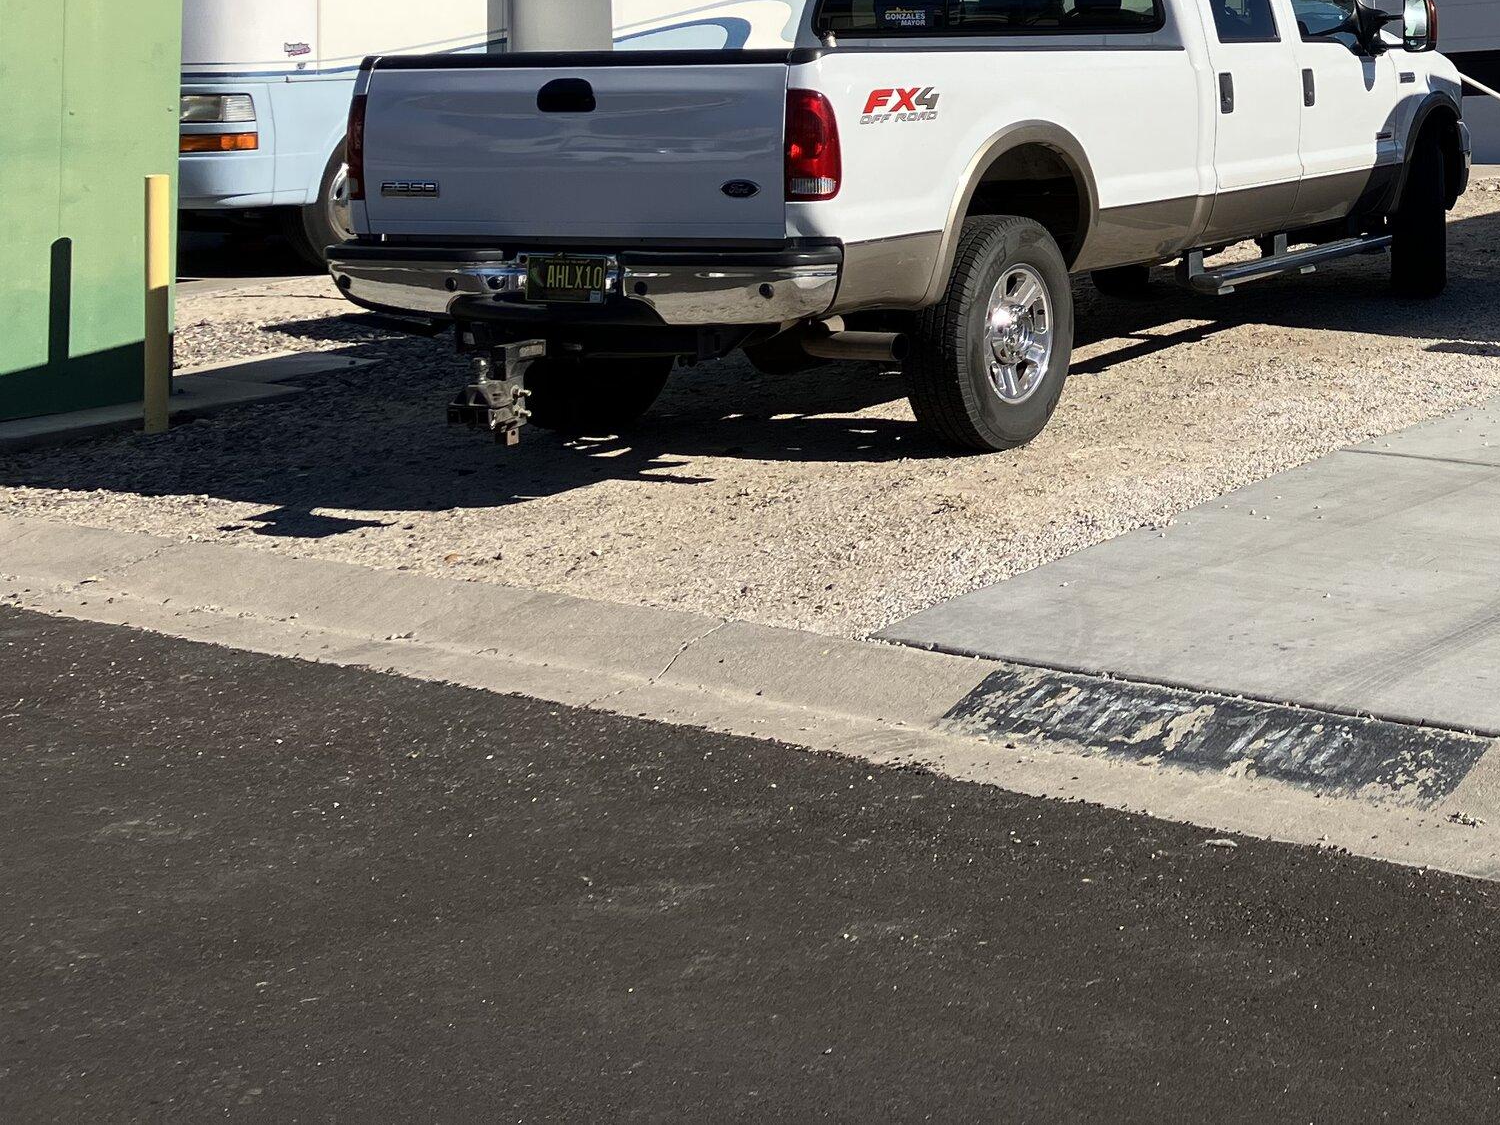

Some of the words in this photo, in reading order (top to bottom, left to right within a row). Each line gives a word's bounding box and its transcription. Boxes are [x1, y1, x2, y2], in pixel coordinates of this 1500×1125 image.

[885, 12, 926, 20] GONZALES
[862, 86, 940, 115] FX4
[860, 113, 892, 125] OFF
[894, 110, 938, 123] ROAD
